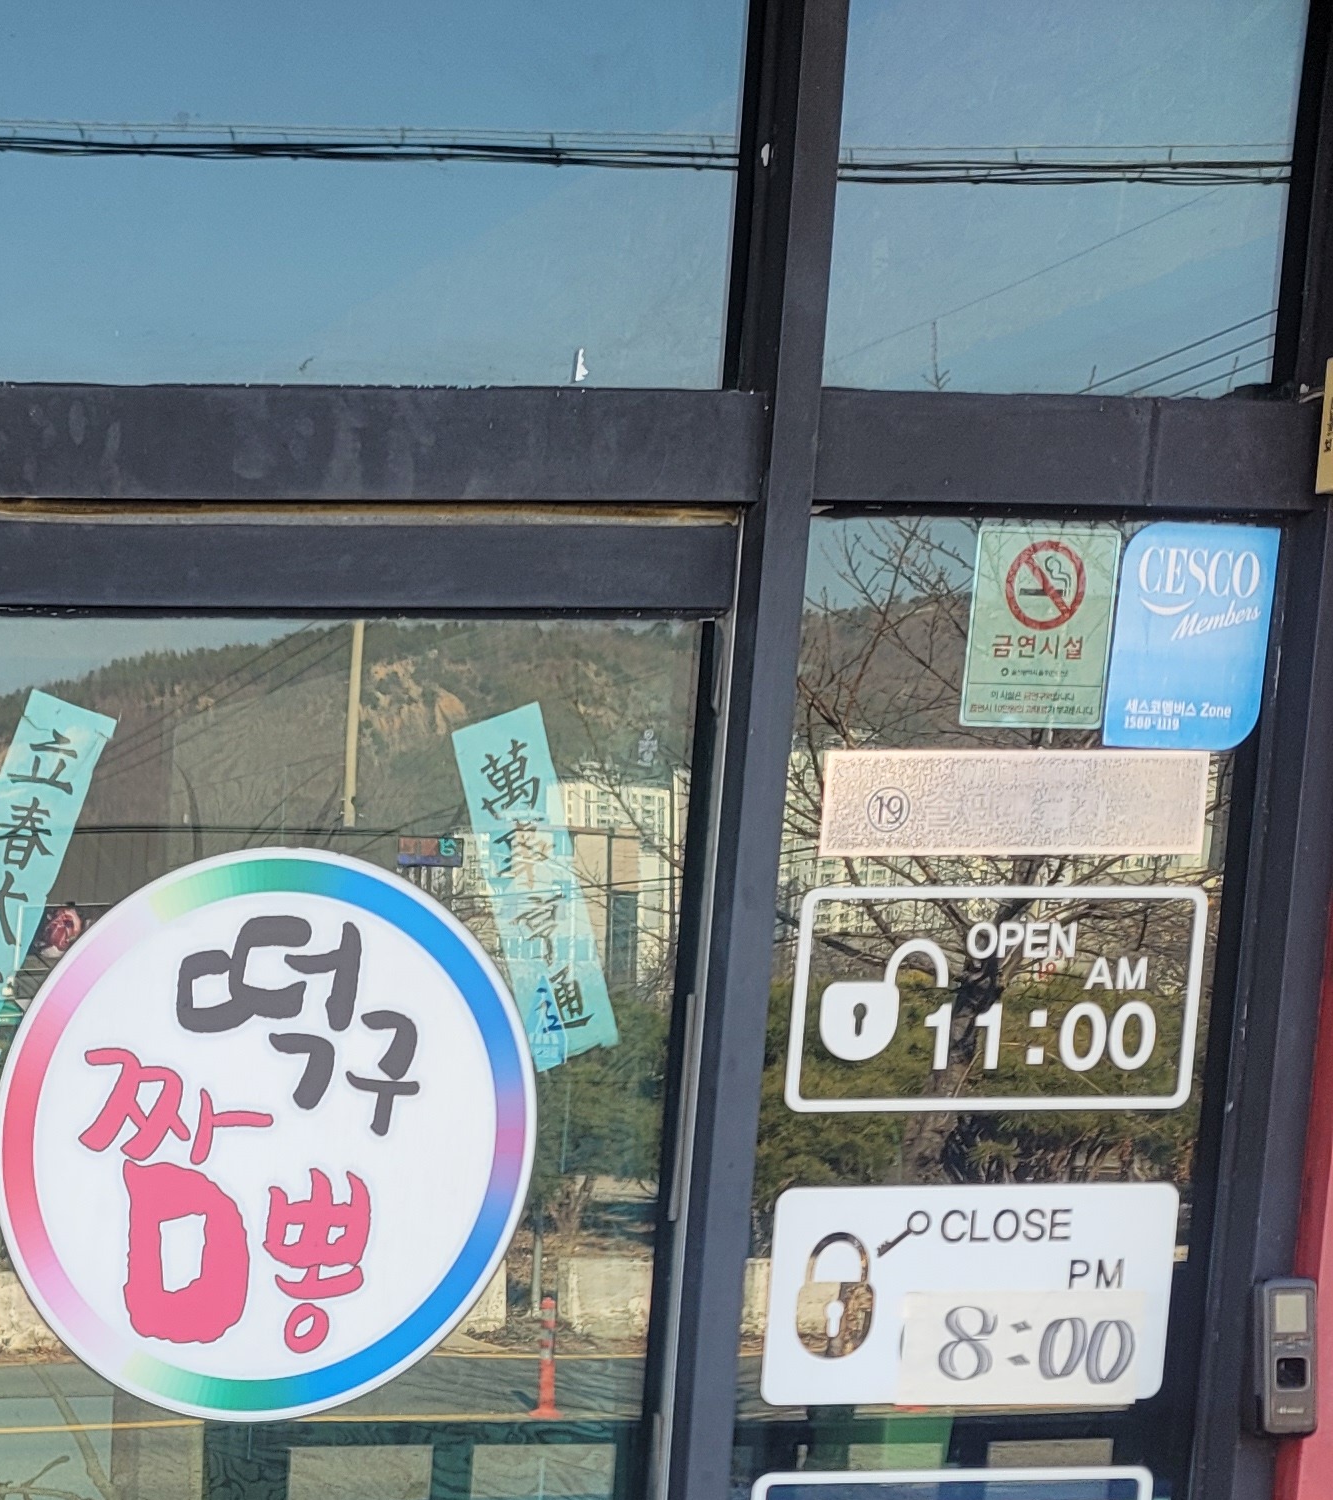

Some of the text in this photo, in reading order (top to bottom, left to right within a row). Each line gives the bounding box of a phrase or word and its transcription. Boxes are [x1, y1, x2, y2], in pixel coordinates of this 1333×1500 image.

[1137, 545, 1261, 600] CESCO
[1170, 600, 1262, 642] Members
[991, 634, 1084, 661] 금연시설
[1199, 702, 1232, 719] Zone
[964, 920, 1079, 960] OPEN
[1084, 957, 1148, 991] AM
[923, 1001, 1157, 1073] 11:00
[78, 1046, 373, 1355] 짬뽕
[939, 1207, 1074, 1244] CLOSE
[1067, 1256, 1126, 1291] PM
[937, 1304, 1136, 1386] 8:00
